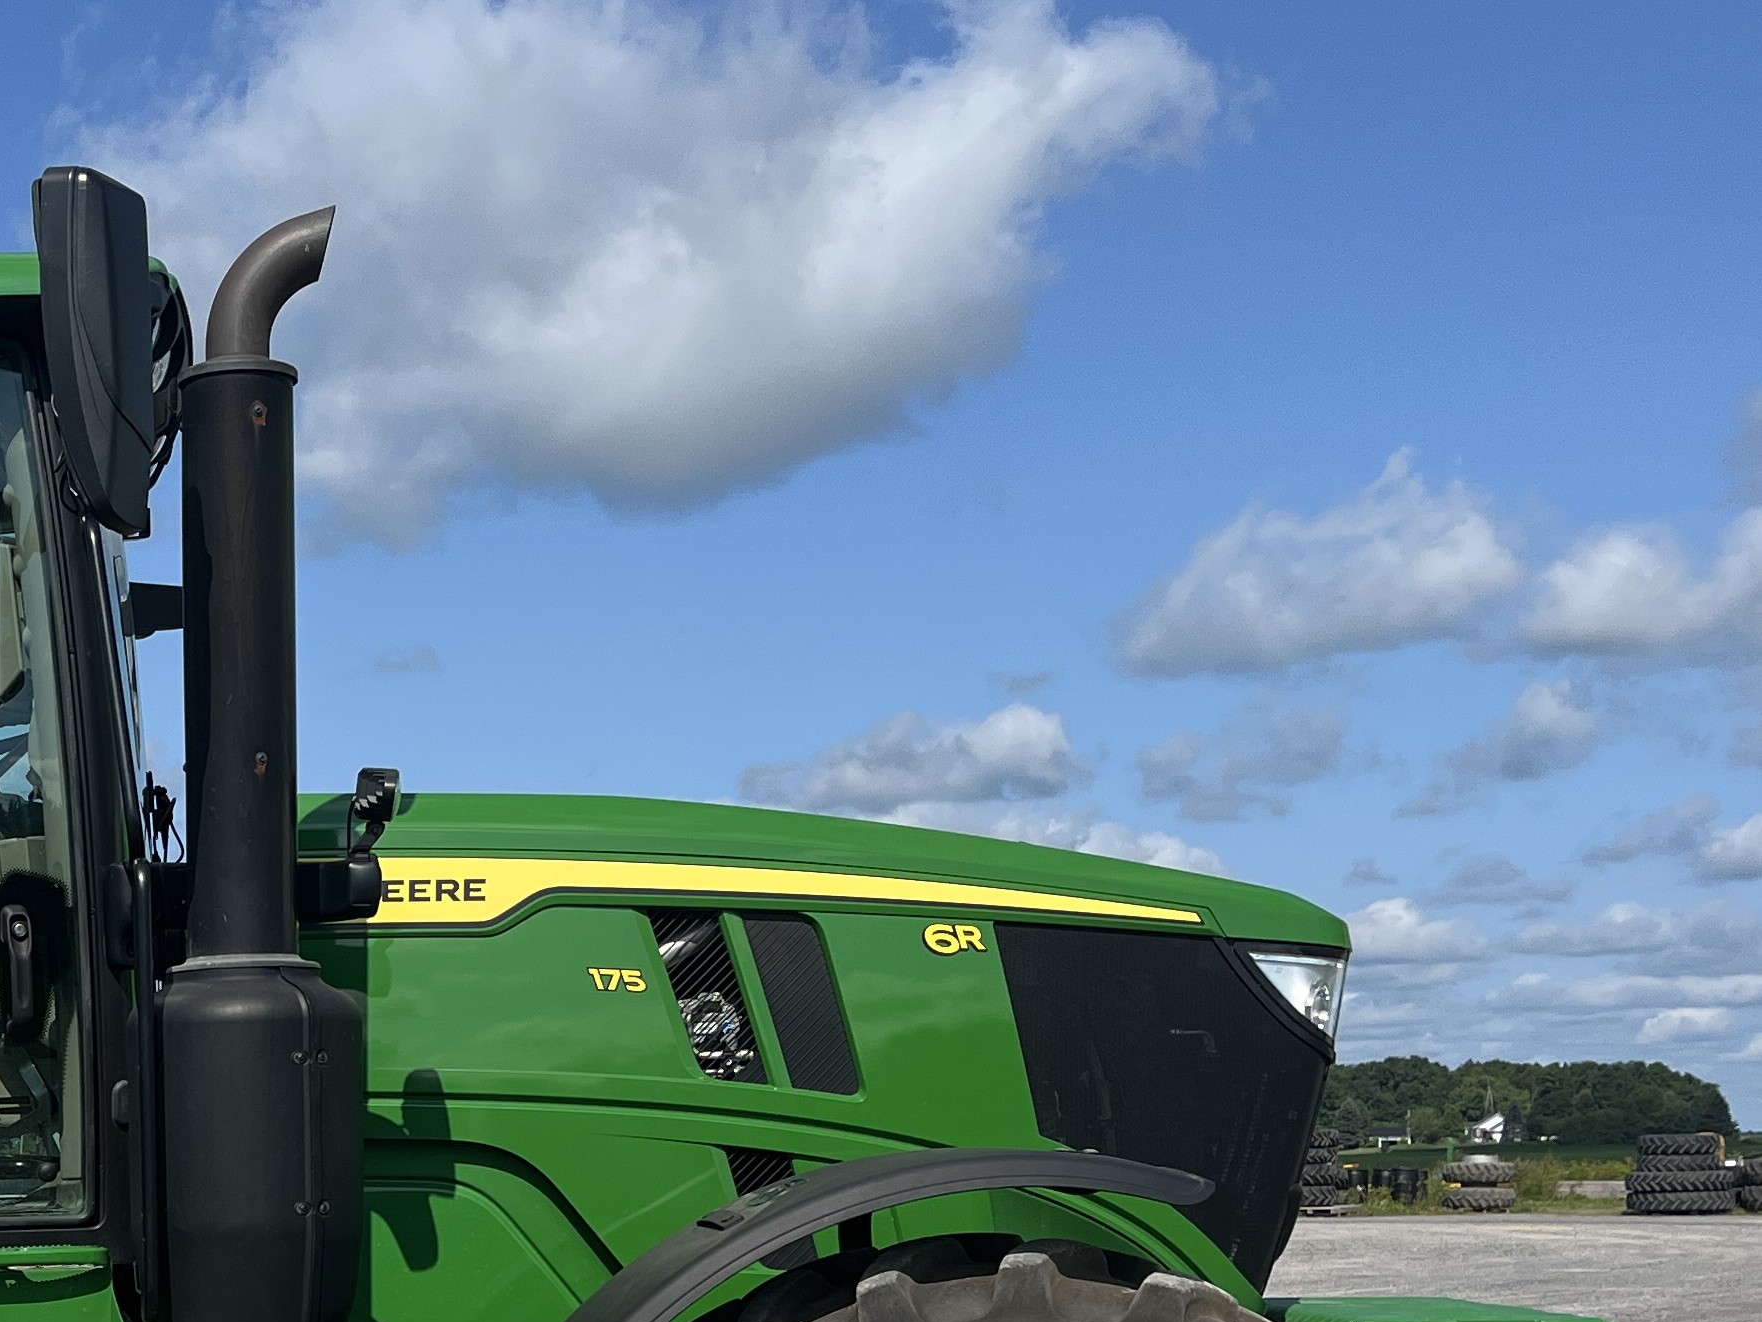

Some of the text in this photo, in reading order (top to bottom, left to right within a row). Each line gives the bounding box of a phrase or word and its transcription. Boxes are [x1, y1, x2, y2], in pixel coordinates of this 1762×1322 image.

[381, 878, 487, 903] EERE
[922, 923, 988, 956] 6R
[586, 966, 648, 993] 175
